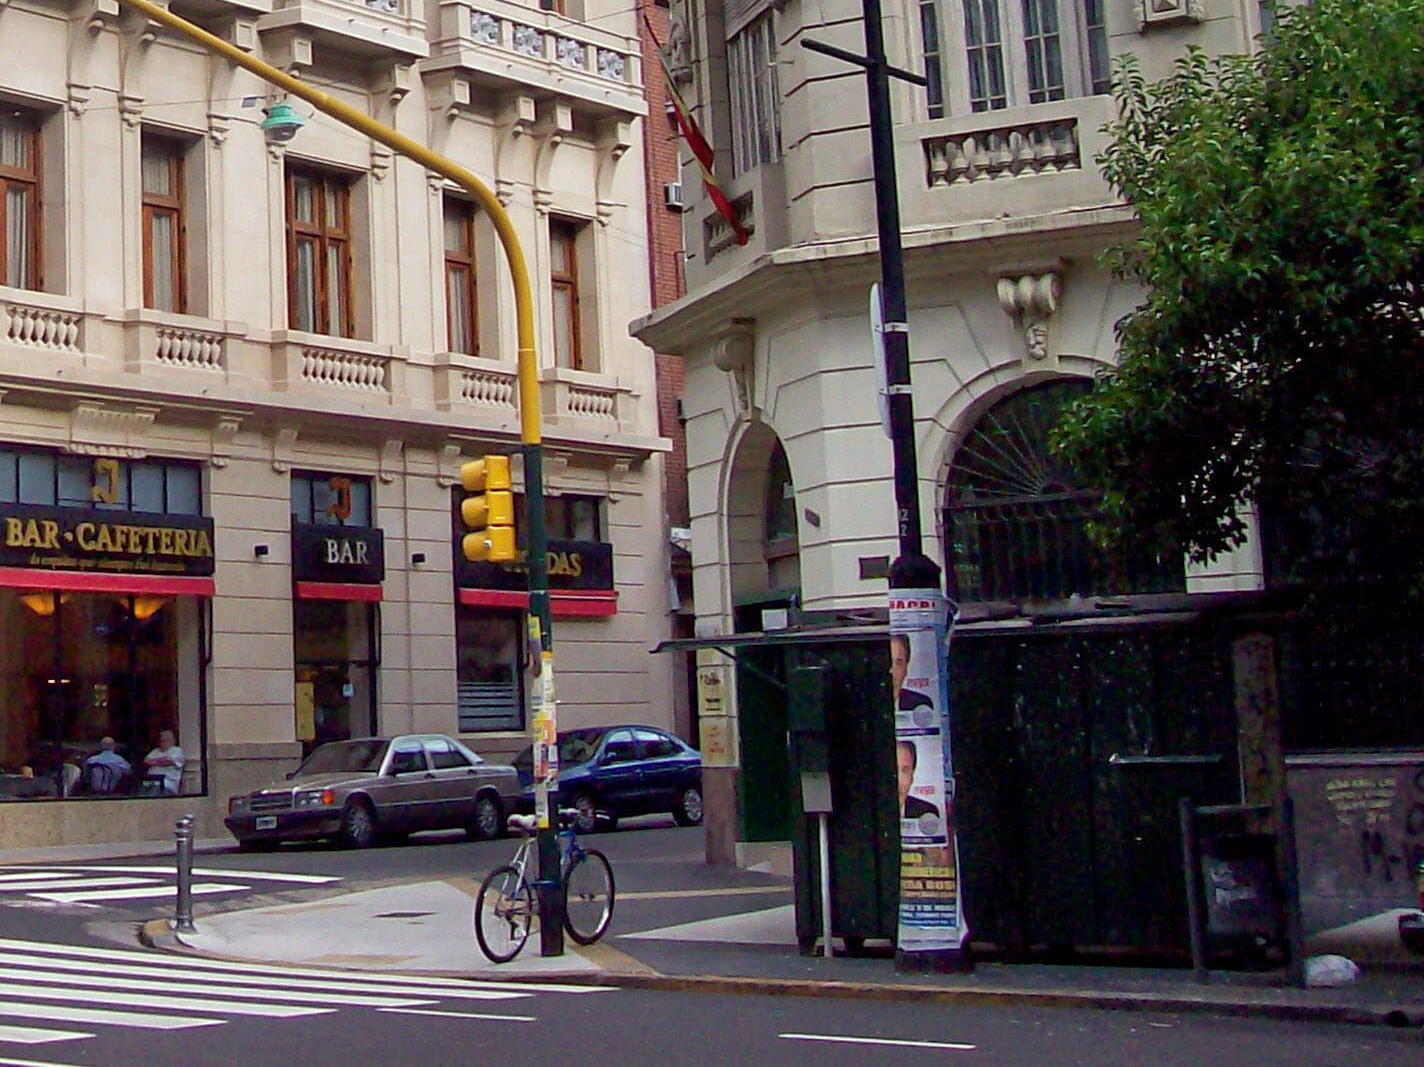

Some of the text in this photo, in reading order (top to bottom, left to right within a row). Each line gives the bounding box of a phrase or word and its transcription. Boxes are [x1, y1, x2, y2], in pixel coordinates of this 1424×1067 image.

[6, 517, 214, 558] BAR CAFETERIA
[326, 539, 369, 565] BAR
